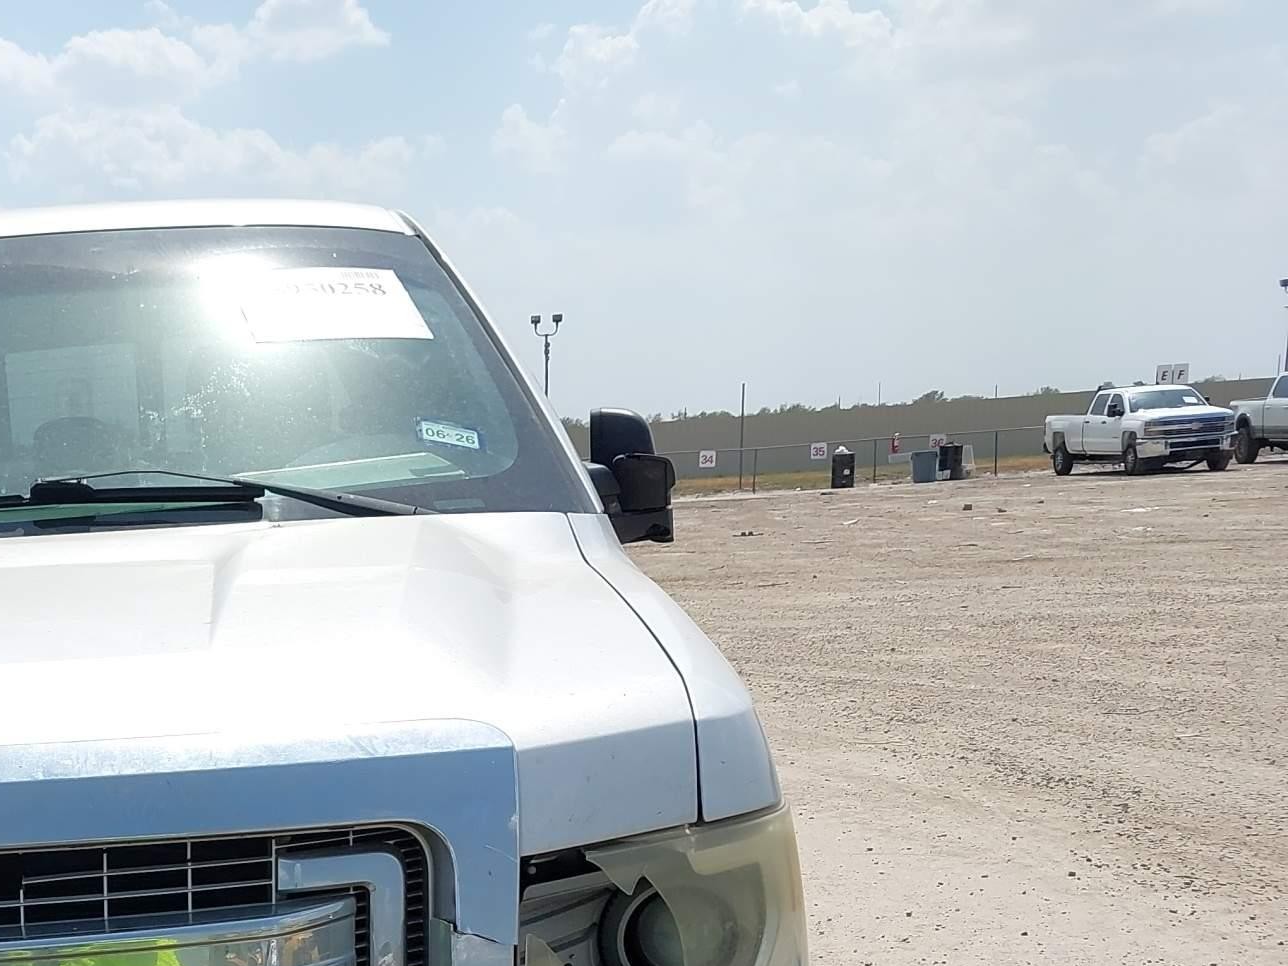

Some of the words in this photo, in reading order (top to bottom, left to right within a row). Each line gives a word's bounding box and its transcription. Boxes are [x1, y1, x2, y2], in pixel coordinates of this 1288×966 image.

[1161, 370, 1169, 381] E
[1177, 369, 1185, 380] F
[454, 433, 476, 444] 26
[812, 446, 825, 457] 35
[701, 454, 713, 465] 34
